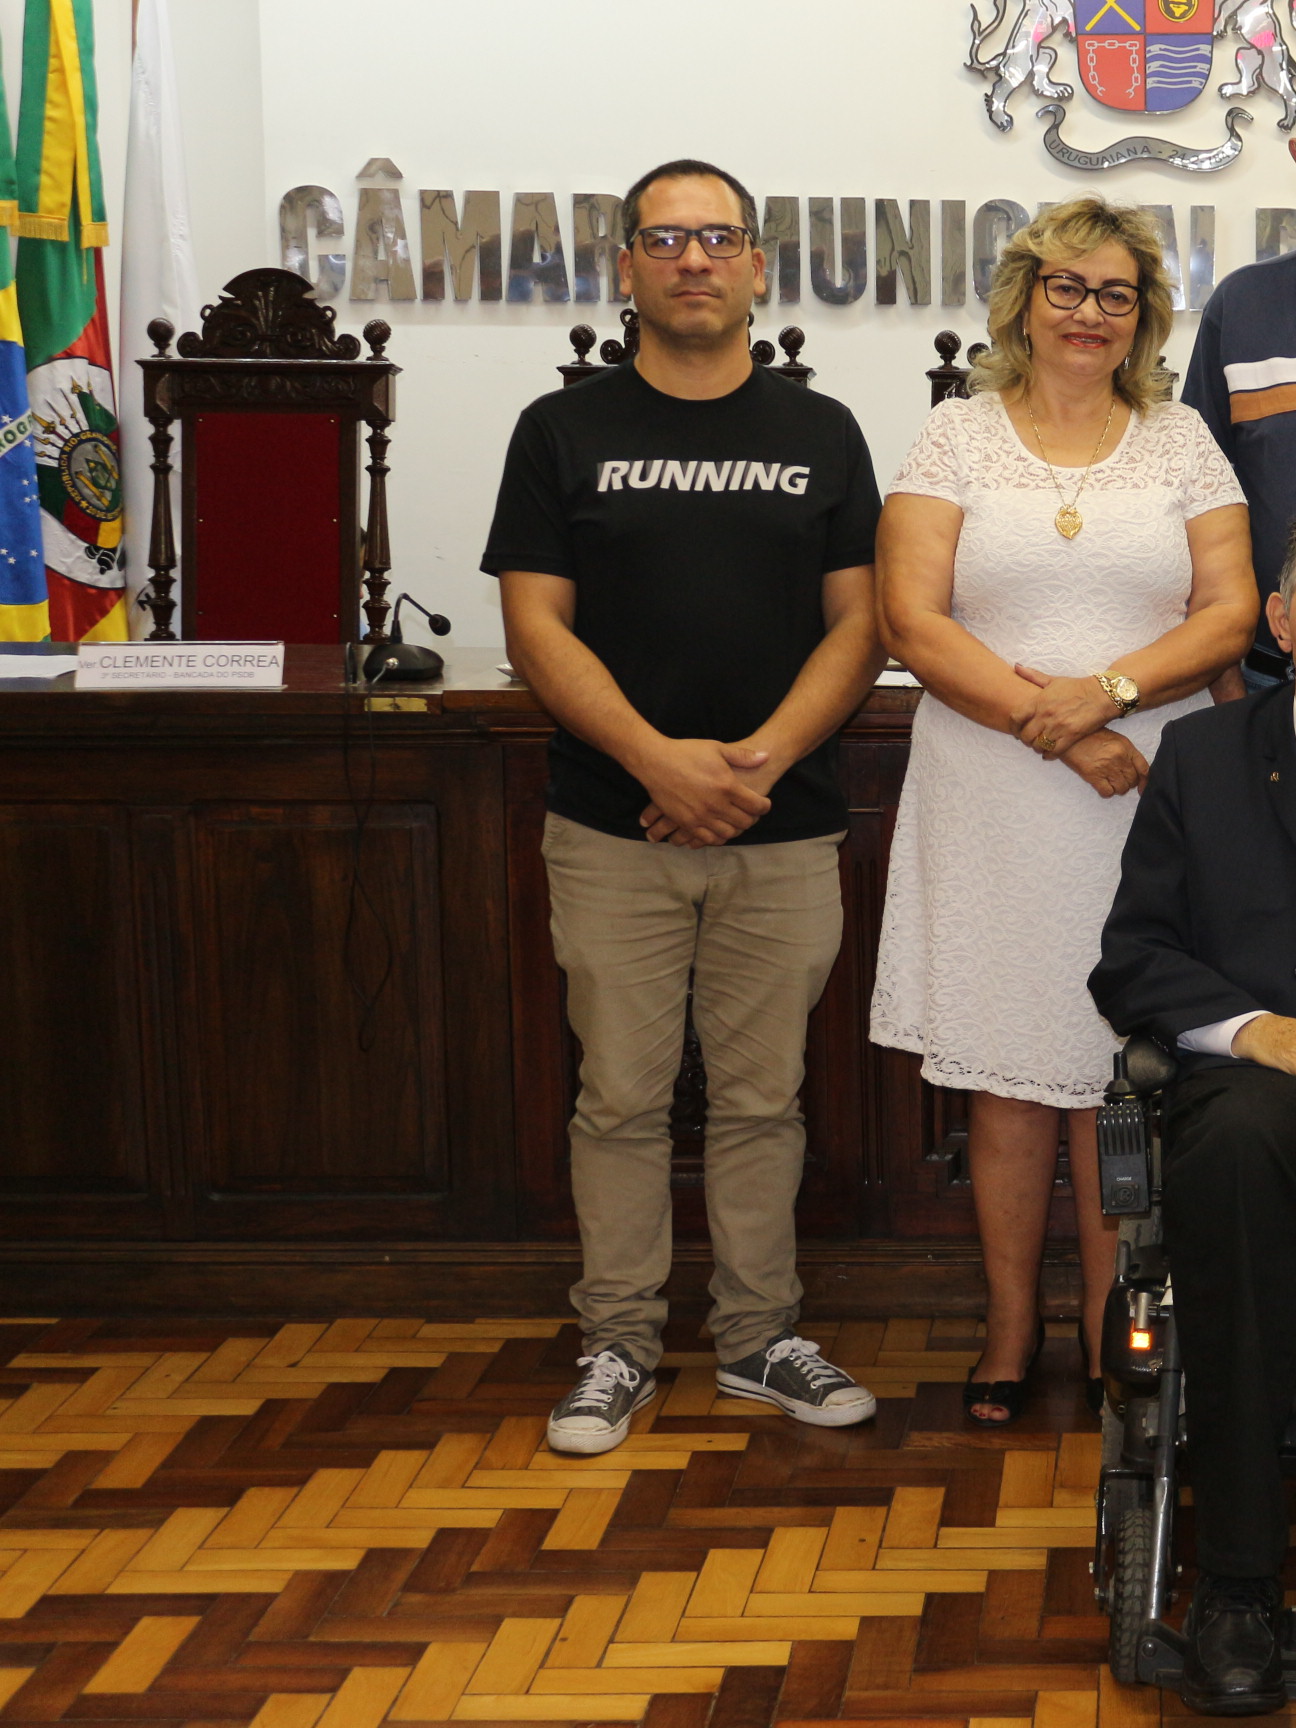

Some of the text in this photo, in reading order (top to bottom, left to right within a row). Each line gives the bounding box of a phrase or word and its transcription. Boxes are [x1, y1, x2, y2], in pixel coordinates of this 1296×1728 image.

[1049, 138, 1151, 167] URUGUAIANA
[279, 157, 634, 303] CÂMAR
[597, 459, 810, 495] RUNNING
[100, 655, 197, 668] CLEMENTE
[203, 654, 280, 668] CORREA
[174, 671, 214, 679] BANCADA
[216, 671, 229, 679] DO
[231, 671, 255, 679] PSDB
